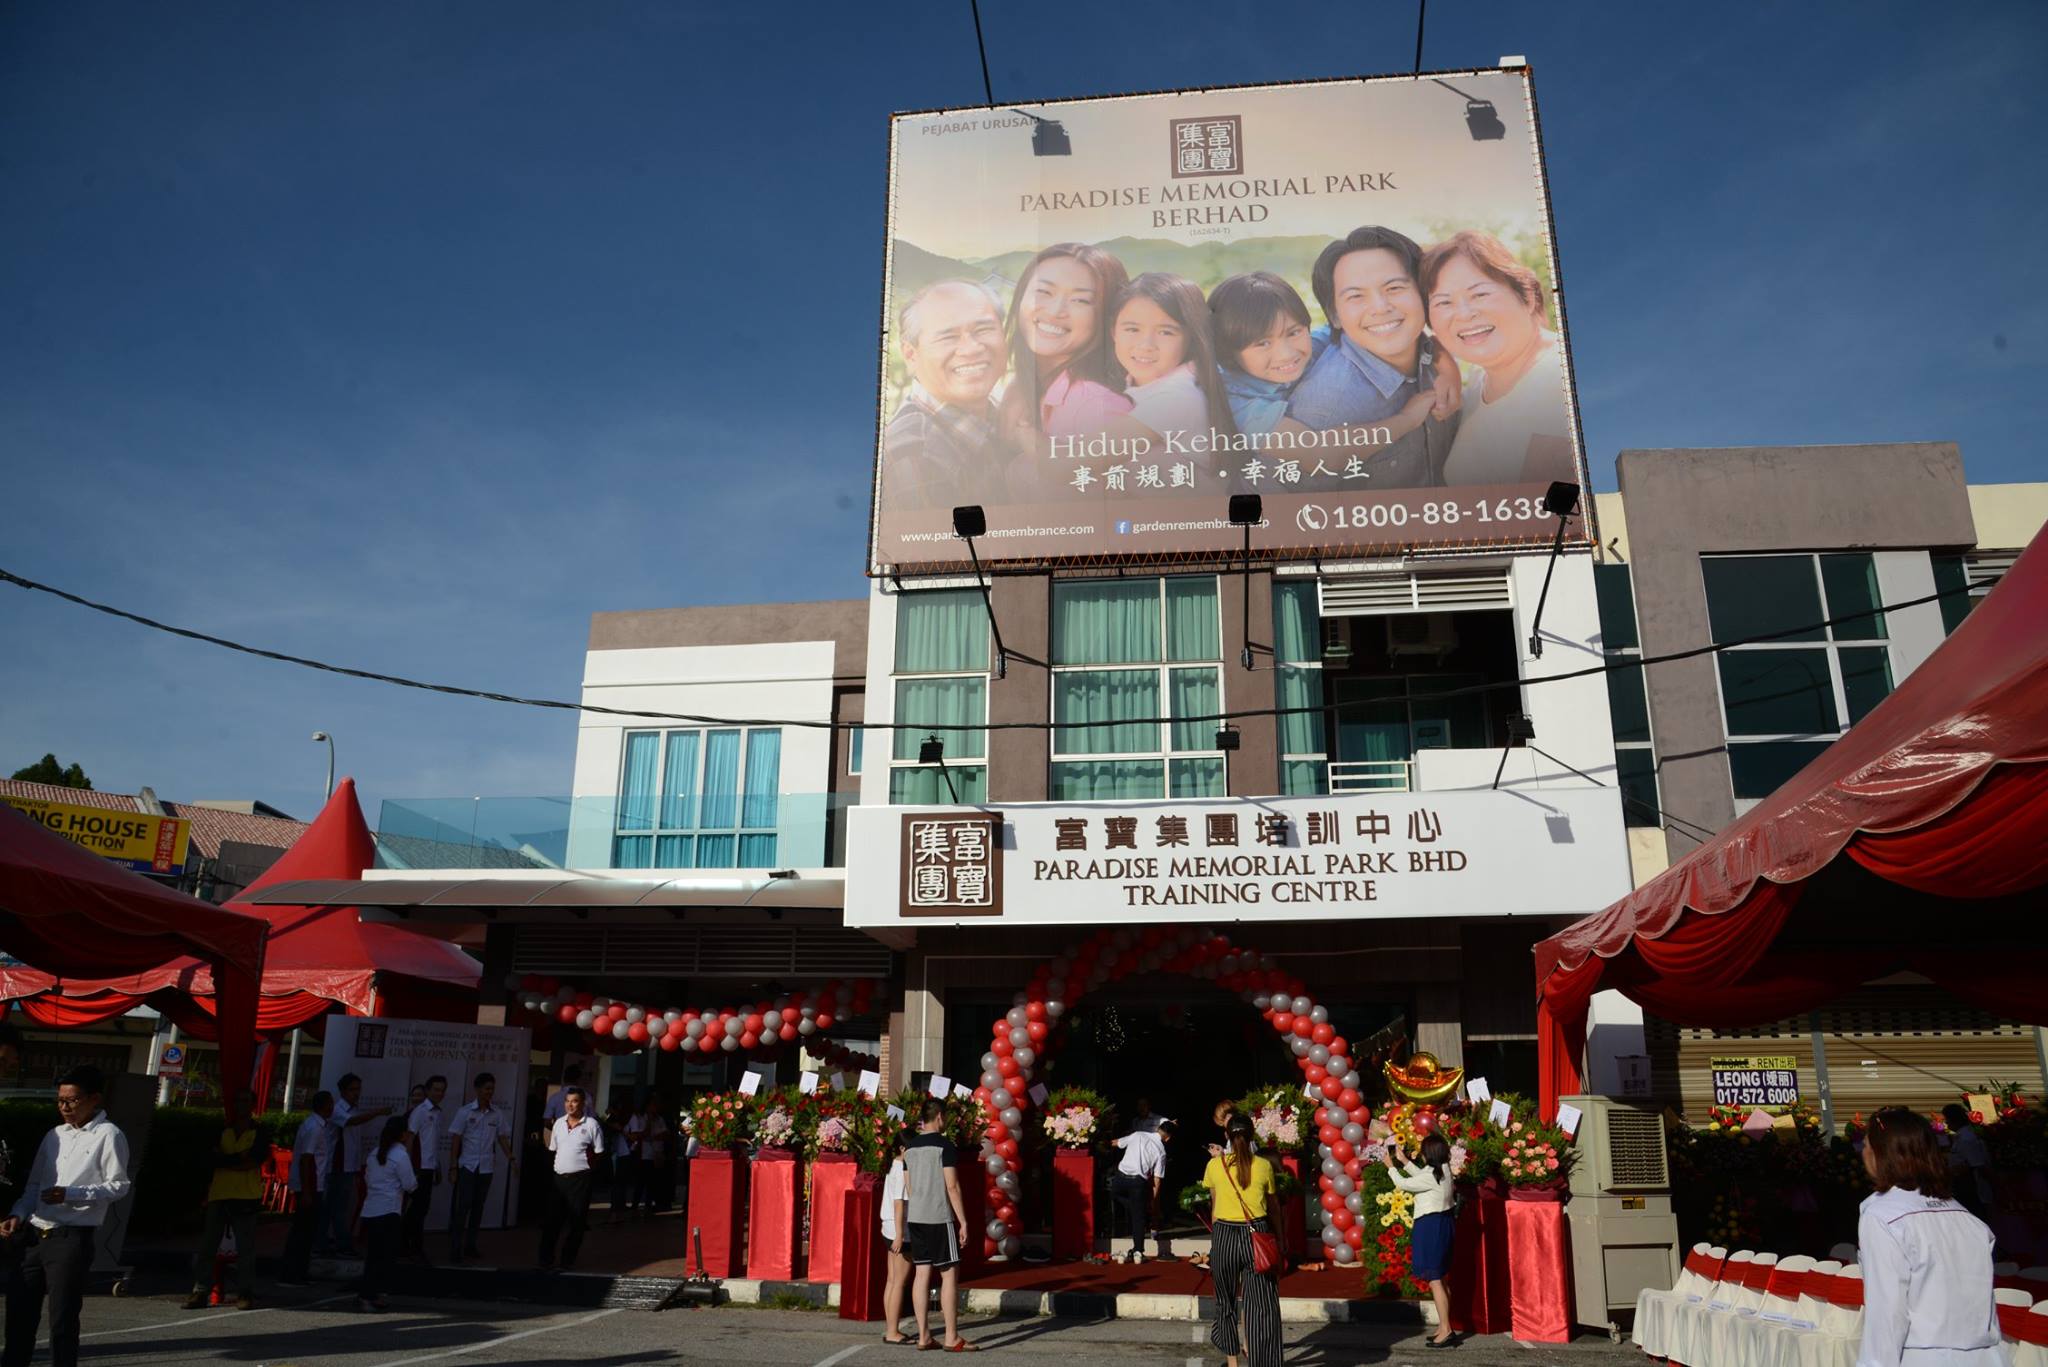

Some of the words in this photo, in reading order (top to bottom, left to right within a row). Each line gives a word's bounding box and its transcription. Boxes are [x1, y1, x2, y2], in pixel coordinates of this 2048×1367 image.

[922, 121, 978, 136] PEJABAT
[1019, 187, 1151, 212] PARADISE
[1160, 176, 1316, 203] MEMORIAL
[1325, 172, 1398, 194] PARK
[1152, 204, 1269, 228] BERHAD
[1049, 431, 1151, 462] Hidup
[1163, 422, 1393, 454] Keharmonian
[1240, 455, 1370, 486] 幸福人生
[1333, 496, 1552, 529] 1800-88-1638
[69, 815, 148, 839] HOUSE
[1054, 808, 1442, 851] 富寶集團培訓中心
[1034, 858, 1159, 881] PARADISE
[1169, 854, 1316, 879] MEMORIAL
[1325, 852, 1398, 875] PARK
[1408, 850, 1468, 873] BHD
[1122, 882, 1261, 906] TRAINING
[1271, 880, 1377, 903] CENTRE
[390, 1038, 428, 1048] TRAINING
[428, 1040, 457, 1049] CENTRE
[1757, 1057, 1779, 1069] RENT
[1716, 1071, 1761, 1087] LEONG
[1717, 1088, 1765, 1104] 017-572
[1767, 1088, 1797, 1104] 6008
